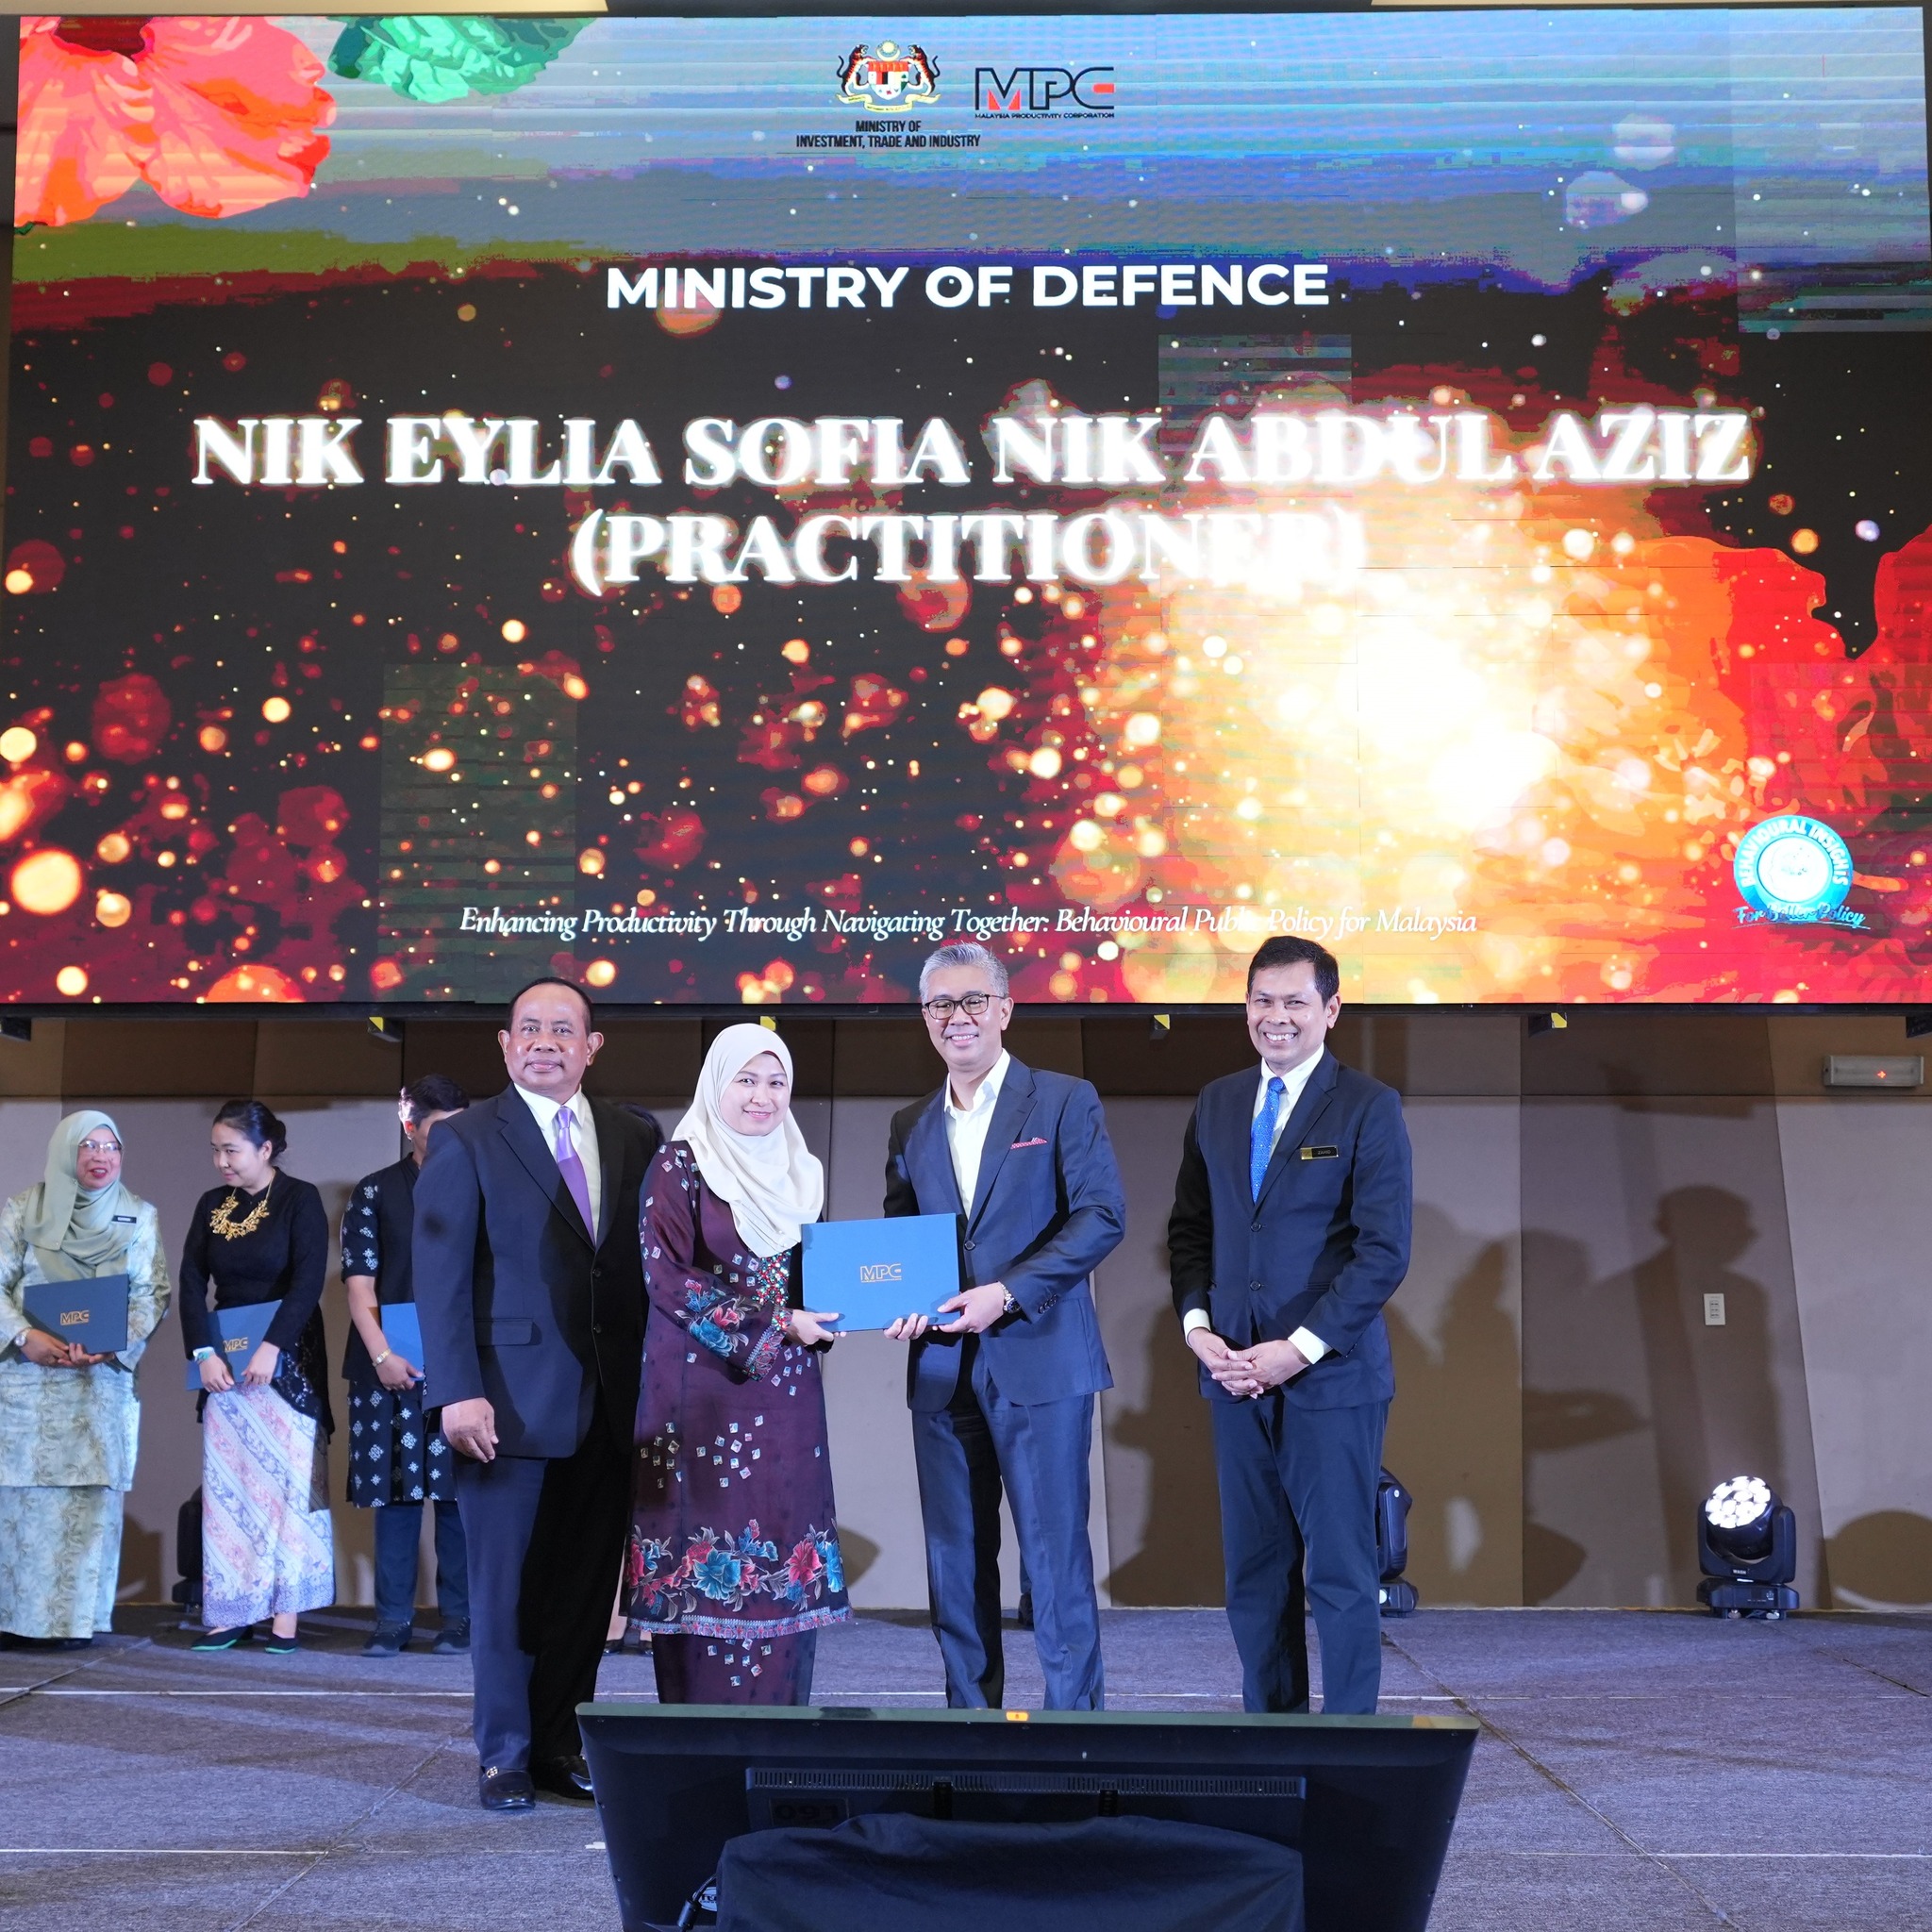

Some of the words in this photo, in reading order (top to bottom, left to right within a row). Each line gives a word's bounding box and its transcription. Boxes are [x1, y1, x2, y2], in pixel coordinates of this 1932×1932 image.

[856, 120, 906, 133] MINISTRY
[908, 120, 922, 133] OF
[795, 135, 866, 150] INVESTMENT,
[869, 135, 903, 148] TRADE
[904, 135, 926, 148] AND
[928, 135, 981, 147] INDUSTRY
[607, 266, 910, 309] MINISTRY
[924, 265, 1013, 308] OF
[1034, 264, 1330, 308] DEFENCE
[192, 418, 365, 487] NIK
[385, 417, 664, 487] EYLIA
[684, 416, 972, 487] SOFIA
[992, 414, 1164, 485] NIK
[1183, 413, 1515, 484] ABDUL
[1532, 412, 1752, 482] AZIZ
[571, 501, 1365, 598] (PRACTITIONER)
[1738, 819, 1807, 888] BEHAVIOURAL
[1808, 824, 1850, 887] INSIGHTS
[459, 907, 578, 941] Enhancing
[582, 907, 717, 942] Productivity
[724, 907, 816, 942] Through
[822, 907, 945, 942] Navigating
[950, 907, 1049, 941] Together:
[1056, 907, 1188, 932] Behavioural
[1193, 906, 1266, 933] Publi
[1269, 907, 1334, 941] Policy
[1334, 907, 1372, 941] for
[1374, 907, 1478, 941] Malaysia
[1817, 902, 1866, 929] Policy
[860, 1263, 902, 1280] MPC
[59, 1309, 90, 1324] MPC
[223, 1337, 248, 1350] MPC
